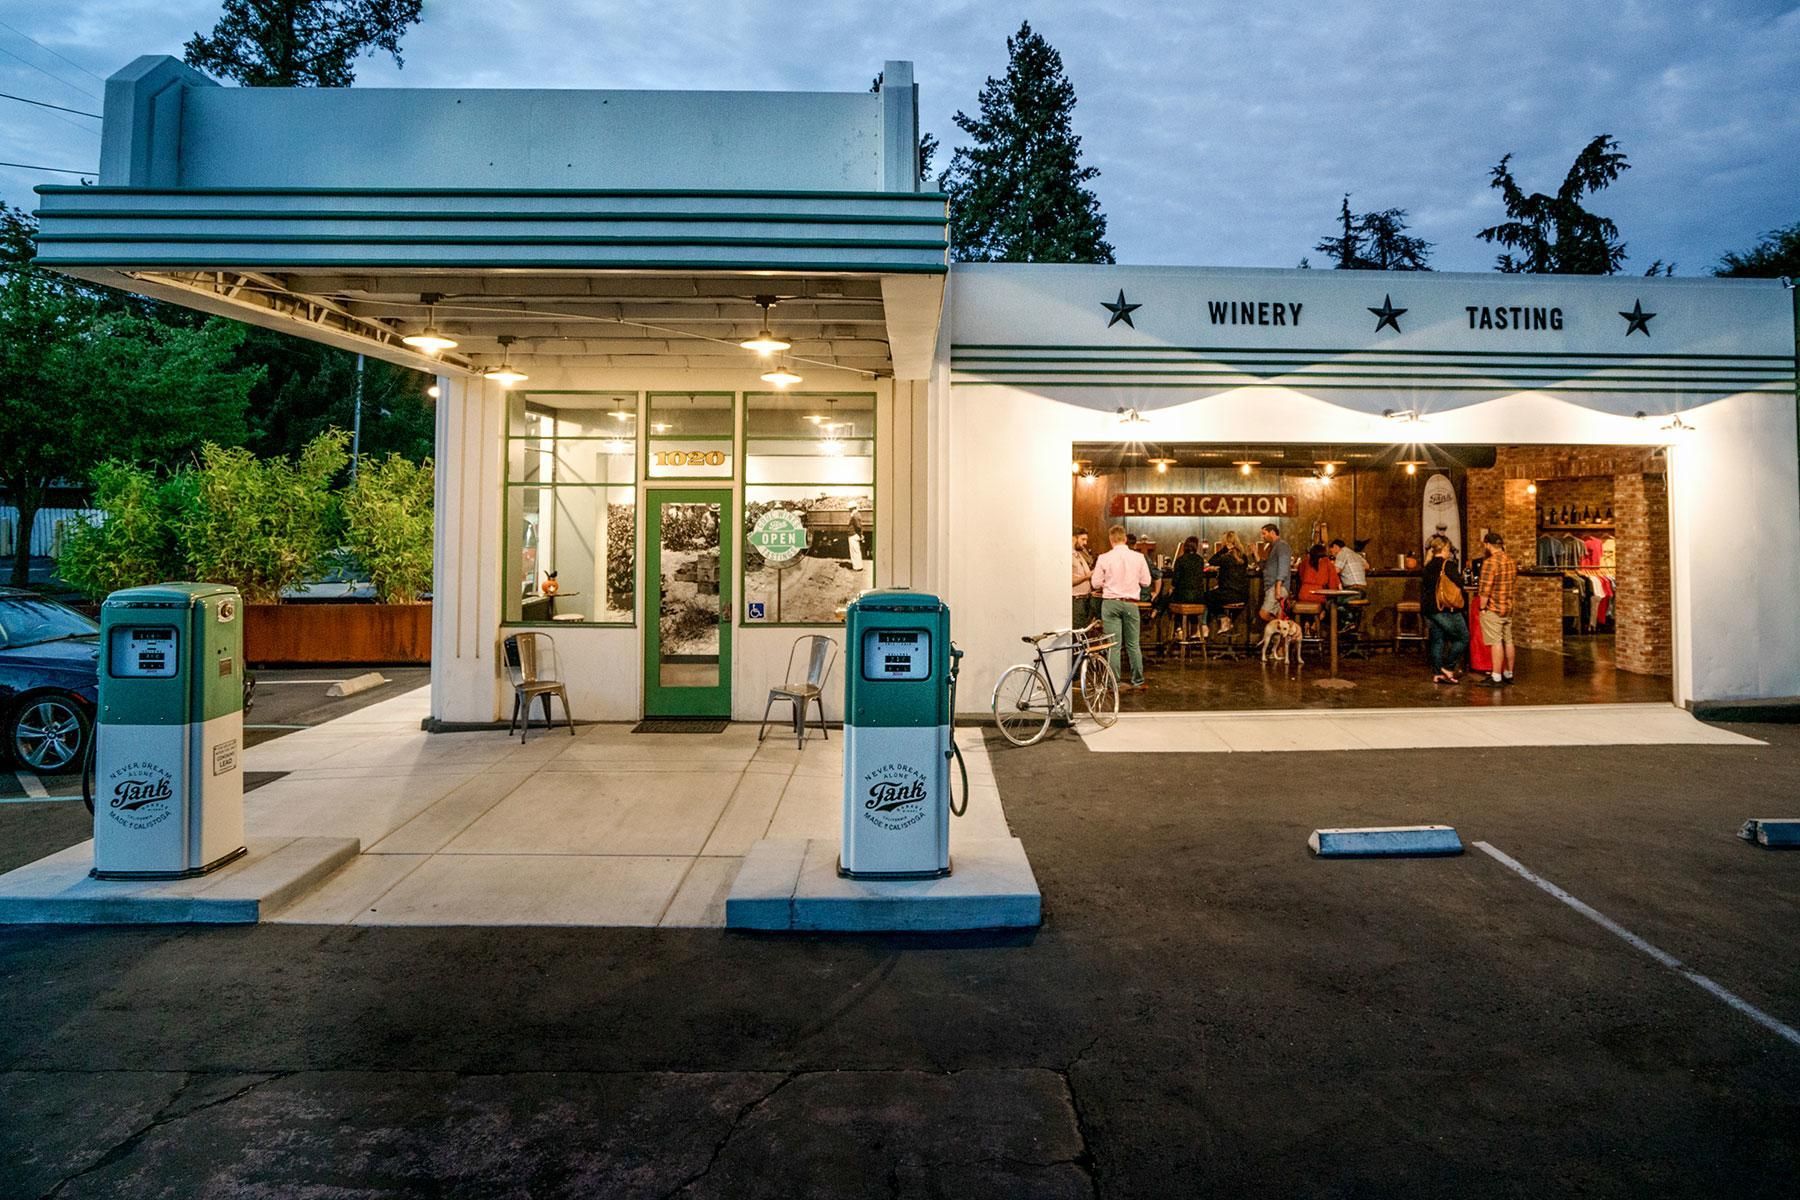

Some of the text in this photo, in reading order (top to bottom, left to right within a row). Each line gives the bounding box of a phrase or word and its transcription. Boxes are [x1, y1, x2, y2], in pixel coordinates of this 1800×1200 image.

[1208, 301, 1563, 330] WINERY TASTING
[655, 450, 726, 466] 1020
[1124, 497, 1288, 514] LUBRICATION
[761, 533, 796, 545] OPEN
[109, 762, 173, 779] NEVER DREAM
[128, 770, 153, 778] ALONE
[864, 763, 927, 781] NEVER DREAM
[110, 777, 173, 810] Tank
[865, 779, 927, 812] Tank
[109, 811, 171, 830] MADE CALISTOGA
[864, 812, 926, 831] MADE CALISTOGA
